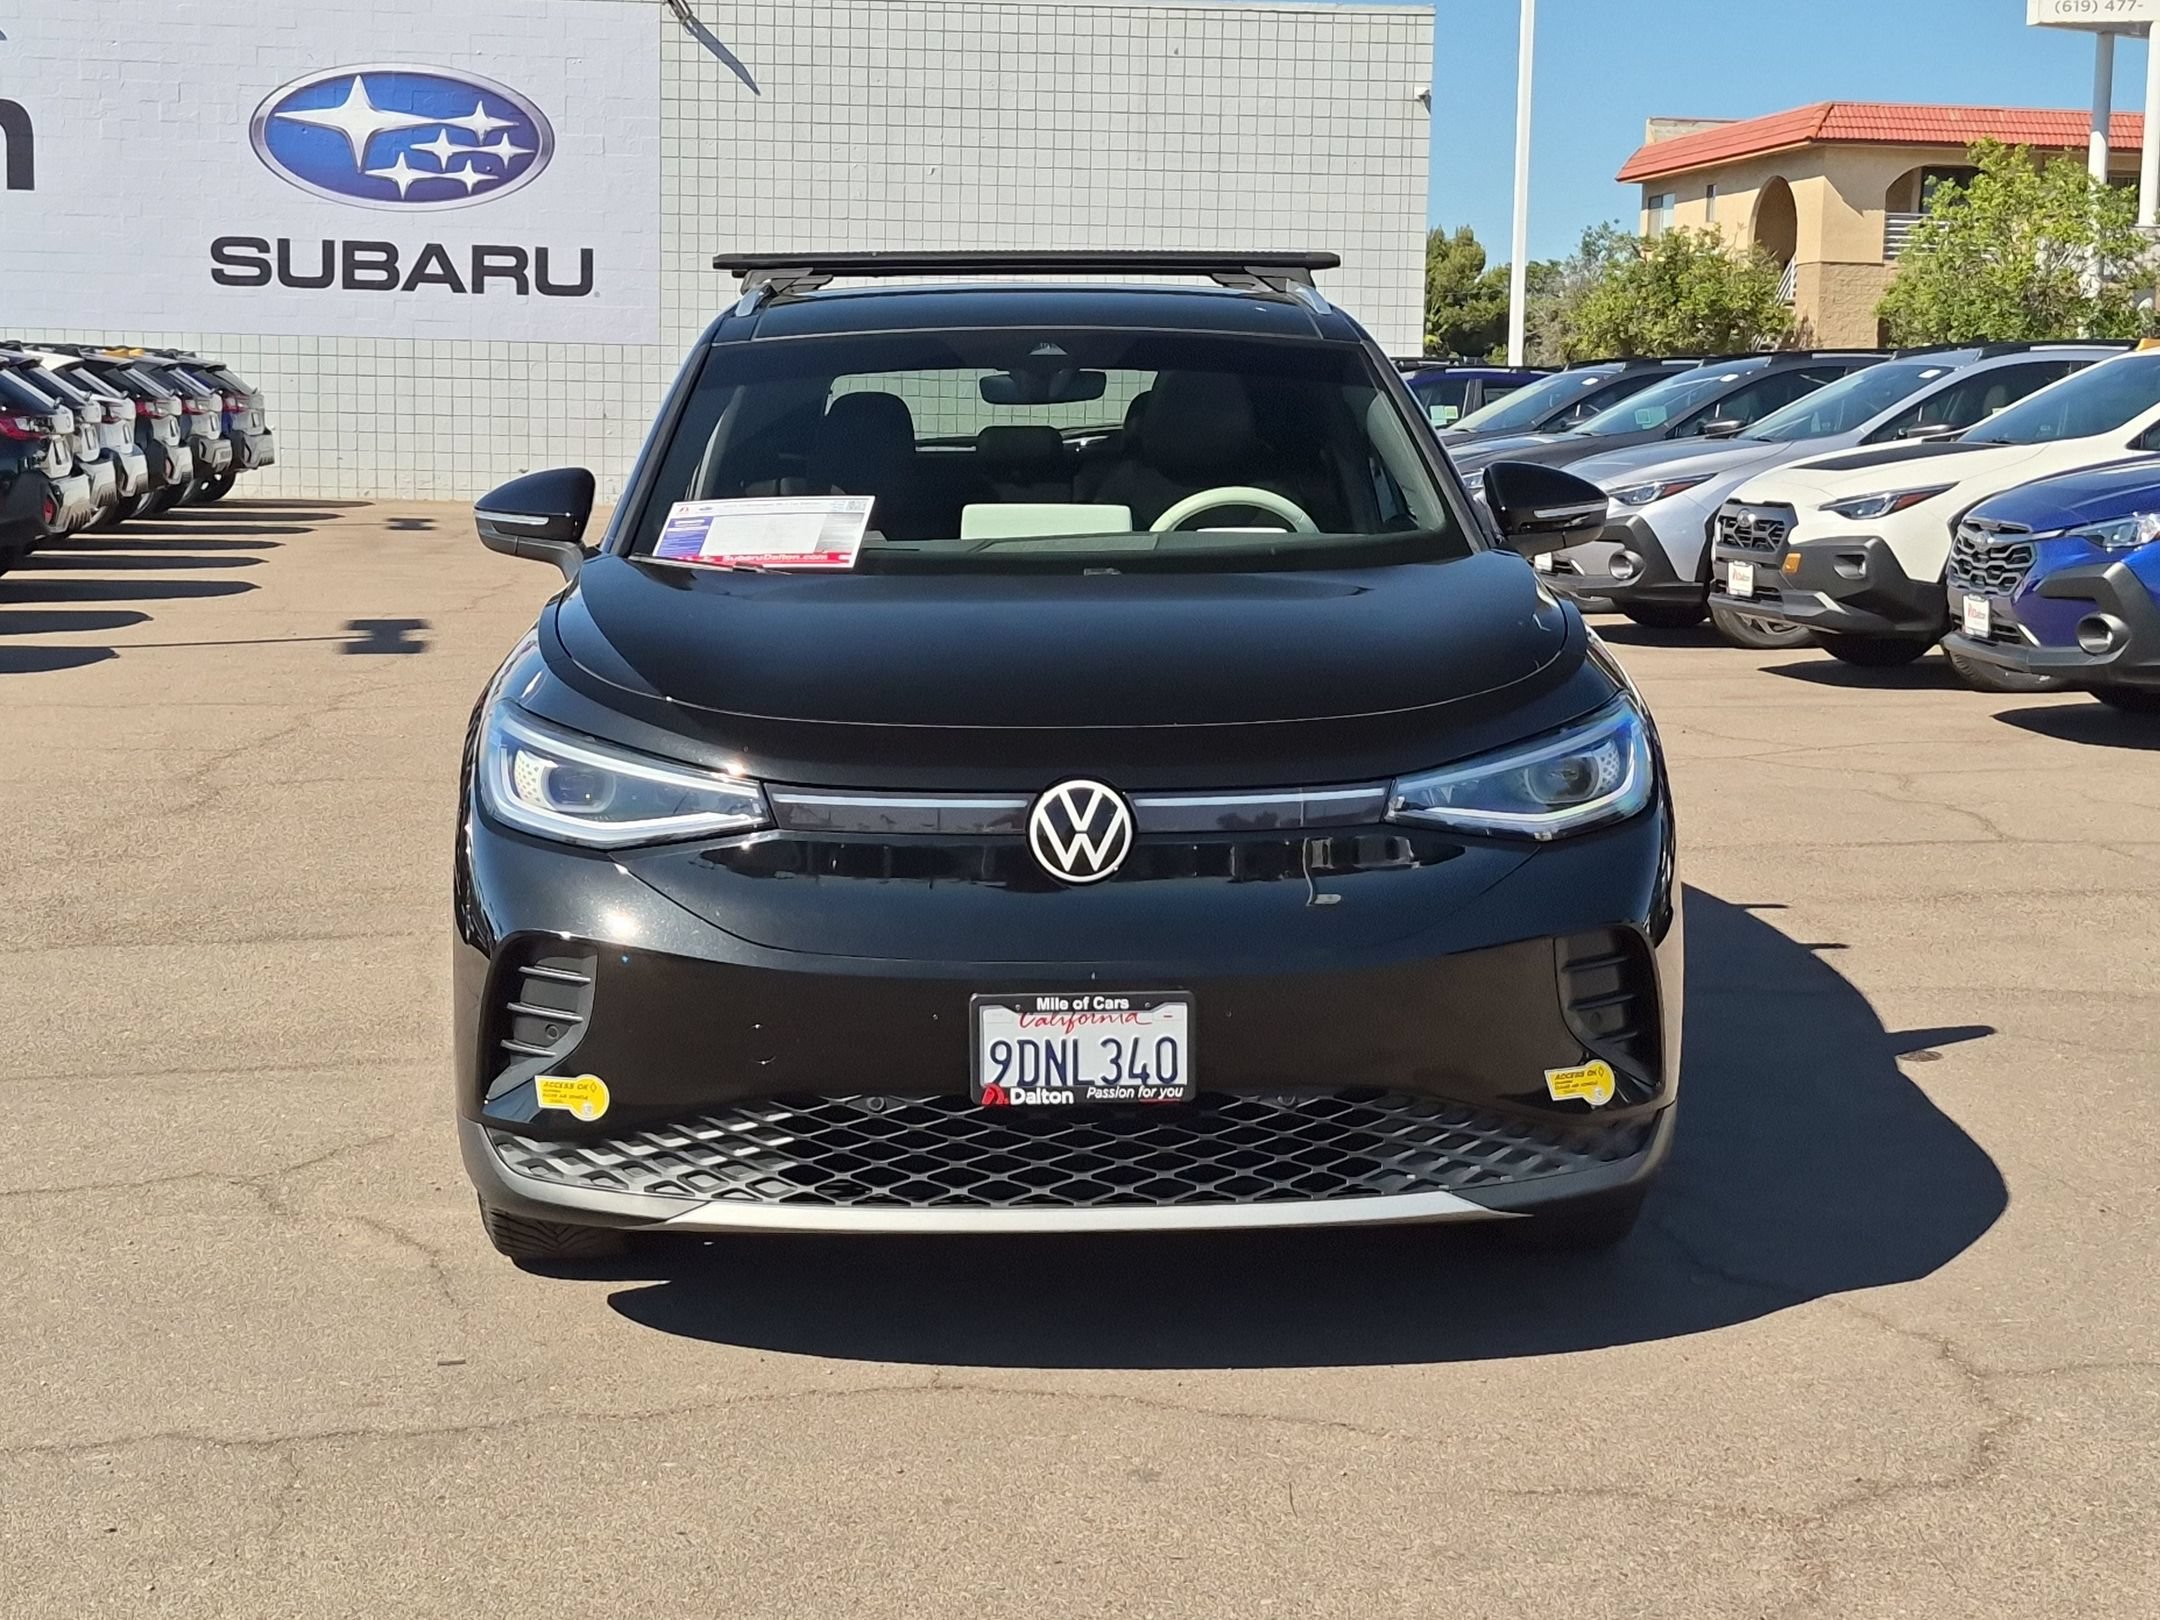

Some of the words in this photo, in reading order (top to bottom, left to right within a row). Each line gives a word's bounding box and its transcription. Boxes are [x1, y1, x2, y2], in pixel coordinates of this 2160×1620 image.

[2055, 0, 2098, 14] (619)
[210, 236, 594, 297] SUBARU
[1036, 997, 1069, 1011] Mile
[1072, 996, 1090, 1010] of
[1093, 996, 1130, 1010] Cars
[1019, 1012, 1152, 1034] California
[989, 1036, 1178, 1087] 9DNL340
[1009, 1087, 1075, 1105] Dalton
[1086, 1086, 1135, 1099] Passion
[1138, 1085, 1157, 1098] for
[1158, 1086, 1184, 1100] you
